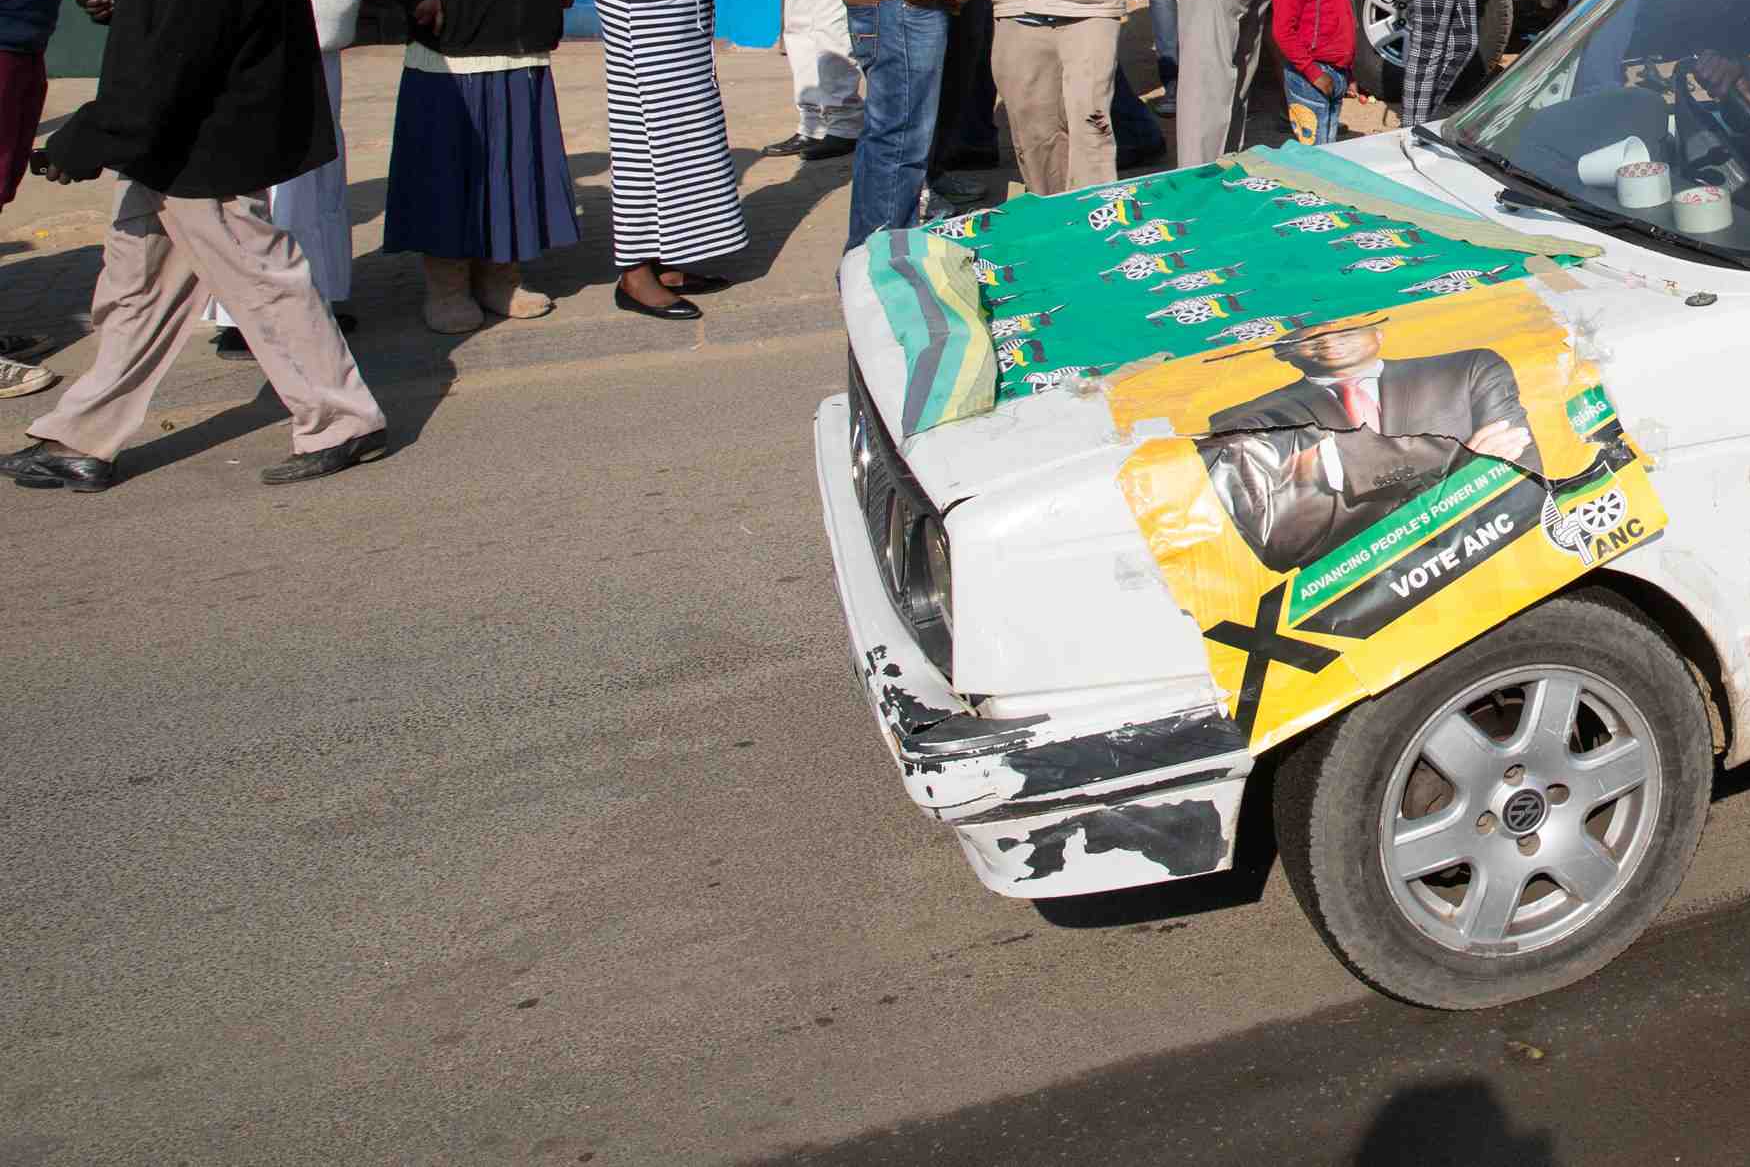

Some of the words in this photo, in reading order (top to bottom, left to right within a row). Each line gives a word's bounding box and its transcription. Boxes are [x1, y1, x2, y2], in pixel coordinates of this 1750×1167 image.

[1300, 549, 1372, 601] ADVANCING
[1370, 513, 1431, 555] PEOPLE'S
[1430, 484, 1473, 517] POWER
[1471, 478, 1489, 496] IN
[1389, 549, 1461, 599] VOTE
[1461, 513, 1515, 558] ANC
[1594, 518, 1646, 560] ANC
